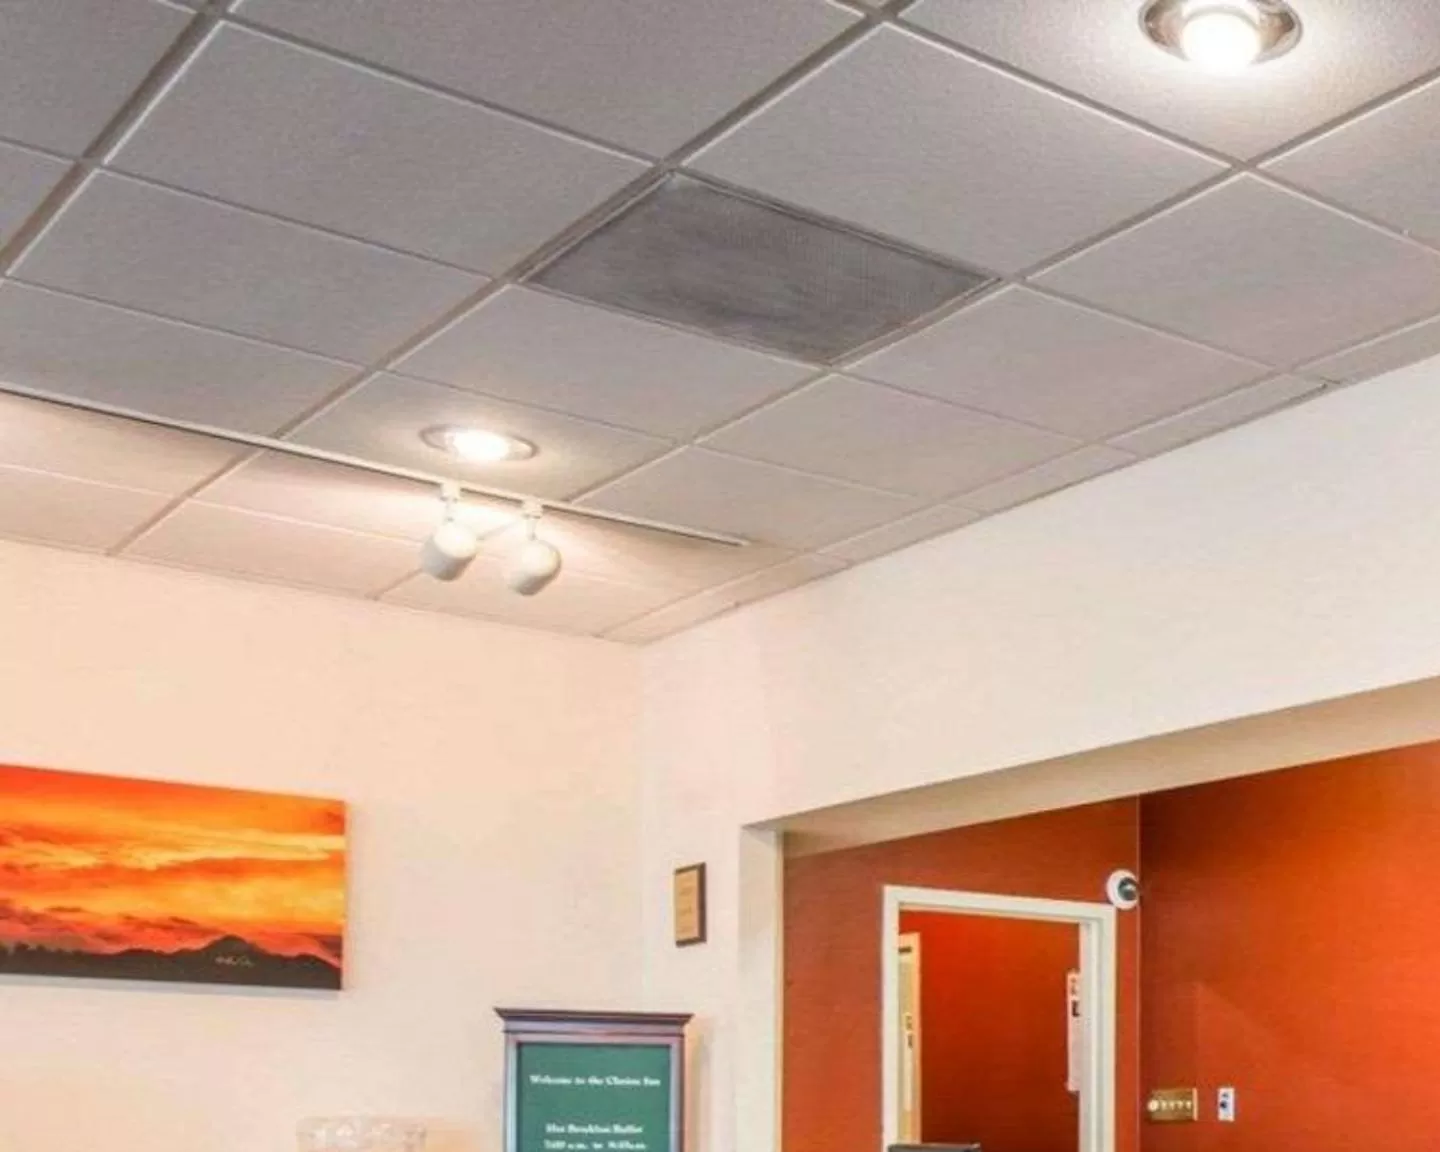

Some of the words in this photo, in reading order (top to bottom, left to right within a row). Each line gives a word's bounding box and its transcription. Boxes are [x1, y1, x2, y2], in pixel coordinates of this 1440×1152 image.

[529, 1074, 572, 1085] Welcome
[574, 1075, 585, 1085] to
[587, 1075, 604, 1086] the
[643, 1076, 661, 1086] Inn
